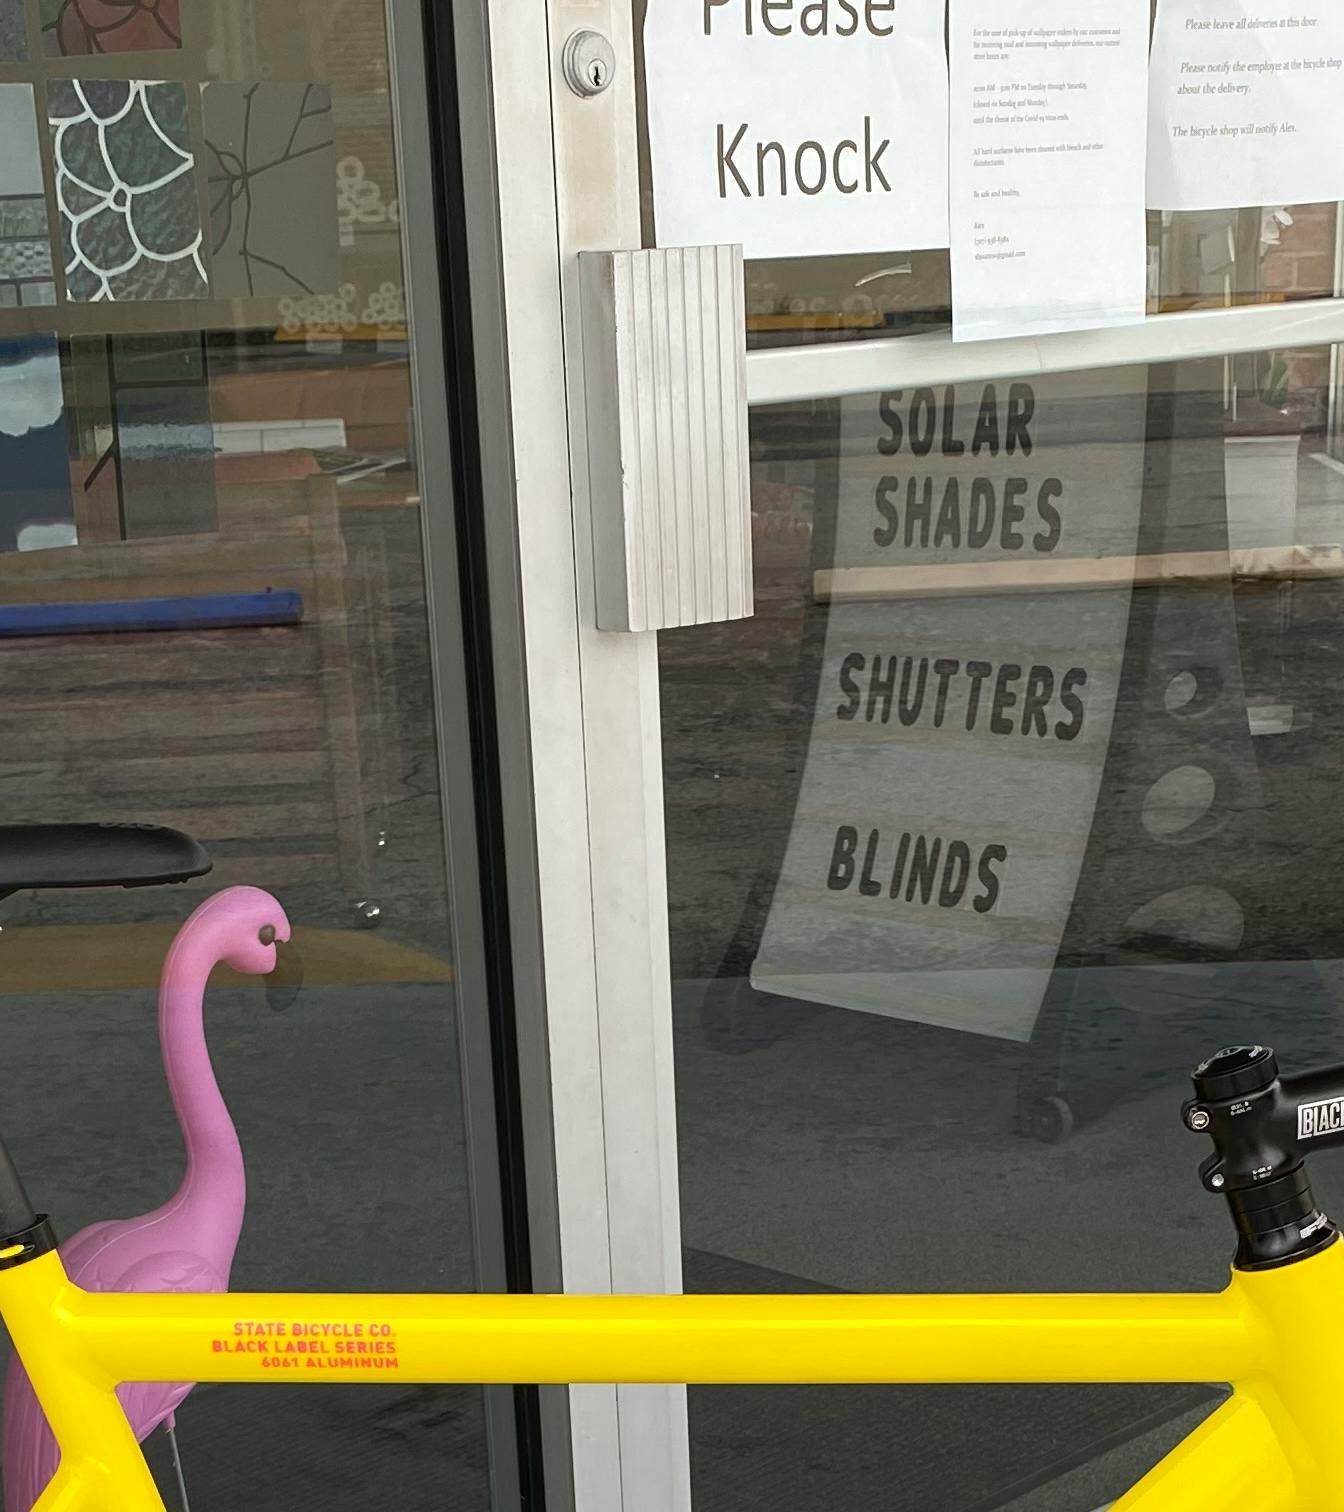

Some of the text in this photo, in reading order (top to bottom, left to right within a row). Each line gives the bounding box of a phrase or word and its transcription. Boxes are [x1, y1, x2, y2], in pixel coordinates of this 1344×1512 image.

[1185, 18, 1211, 30] Please
[1213, 18, 1235, 29] leave
[1235, 18, 1246, 29] all
[1180, 62, 1205, 73] Please
[1208, 61, 1230, 75] notify
[1233, 61, 1246, 72] the
[1177, 83, 1200, 95] about
[1203, 83, 1216, 94] the
[1172, 126, 1189, 137] The
[1190, 125, 1218, 138] bicycle
[1219, 123, 1239, 137] shop
[716, 116, 891, 198] Knock
[877, 382, 1037, 458] SOLAR
[872, 475, 1065, 553] SHADES
[835, 651, 1088, 742] SHUTTERS
[826, 825, 1009, 914] BLINDS
[233, 1322, 397, 1338] STATE BICYCLE CO.
[212, 1340, 396, 1354] BLACK LABEL SERIES
[261, 1356, 399, 1369] 6061 ALUMINUM
